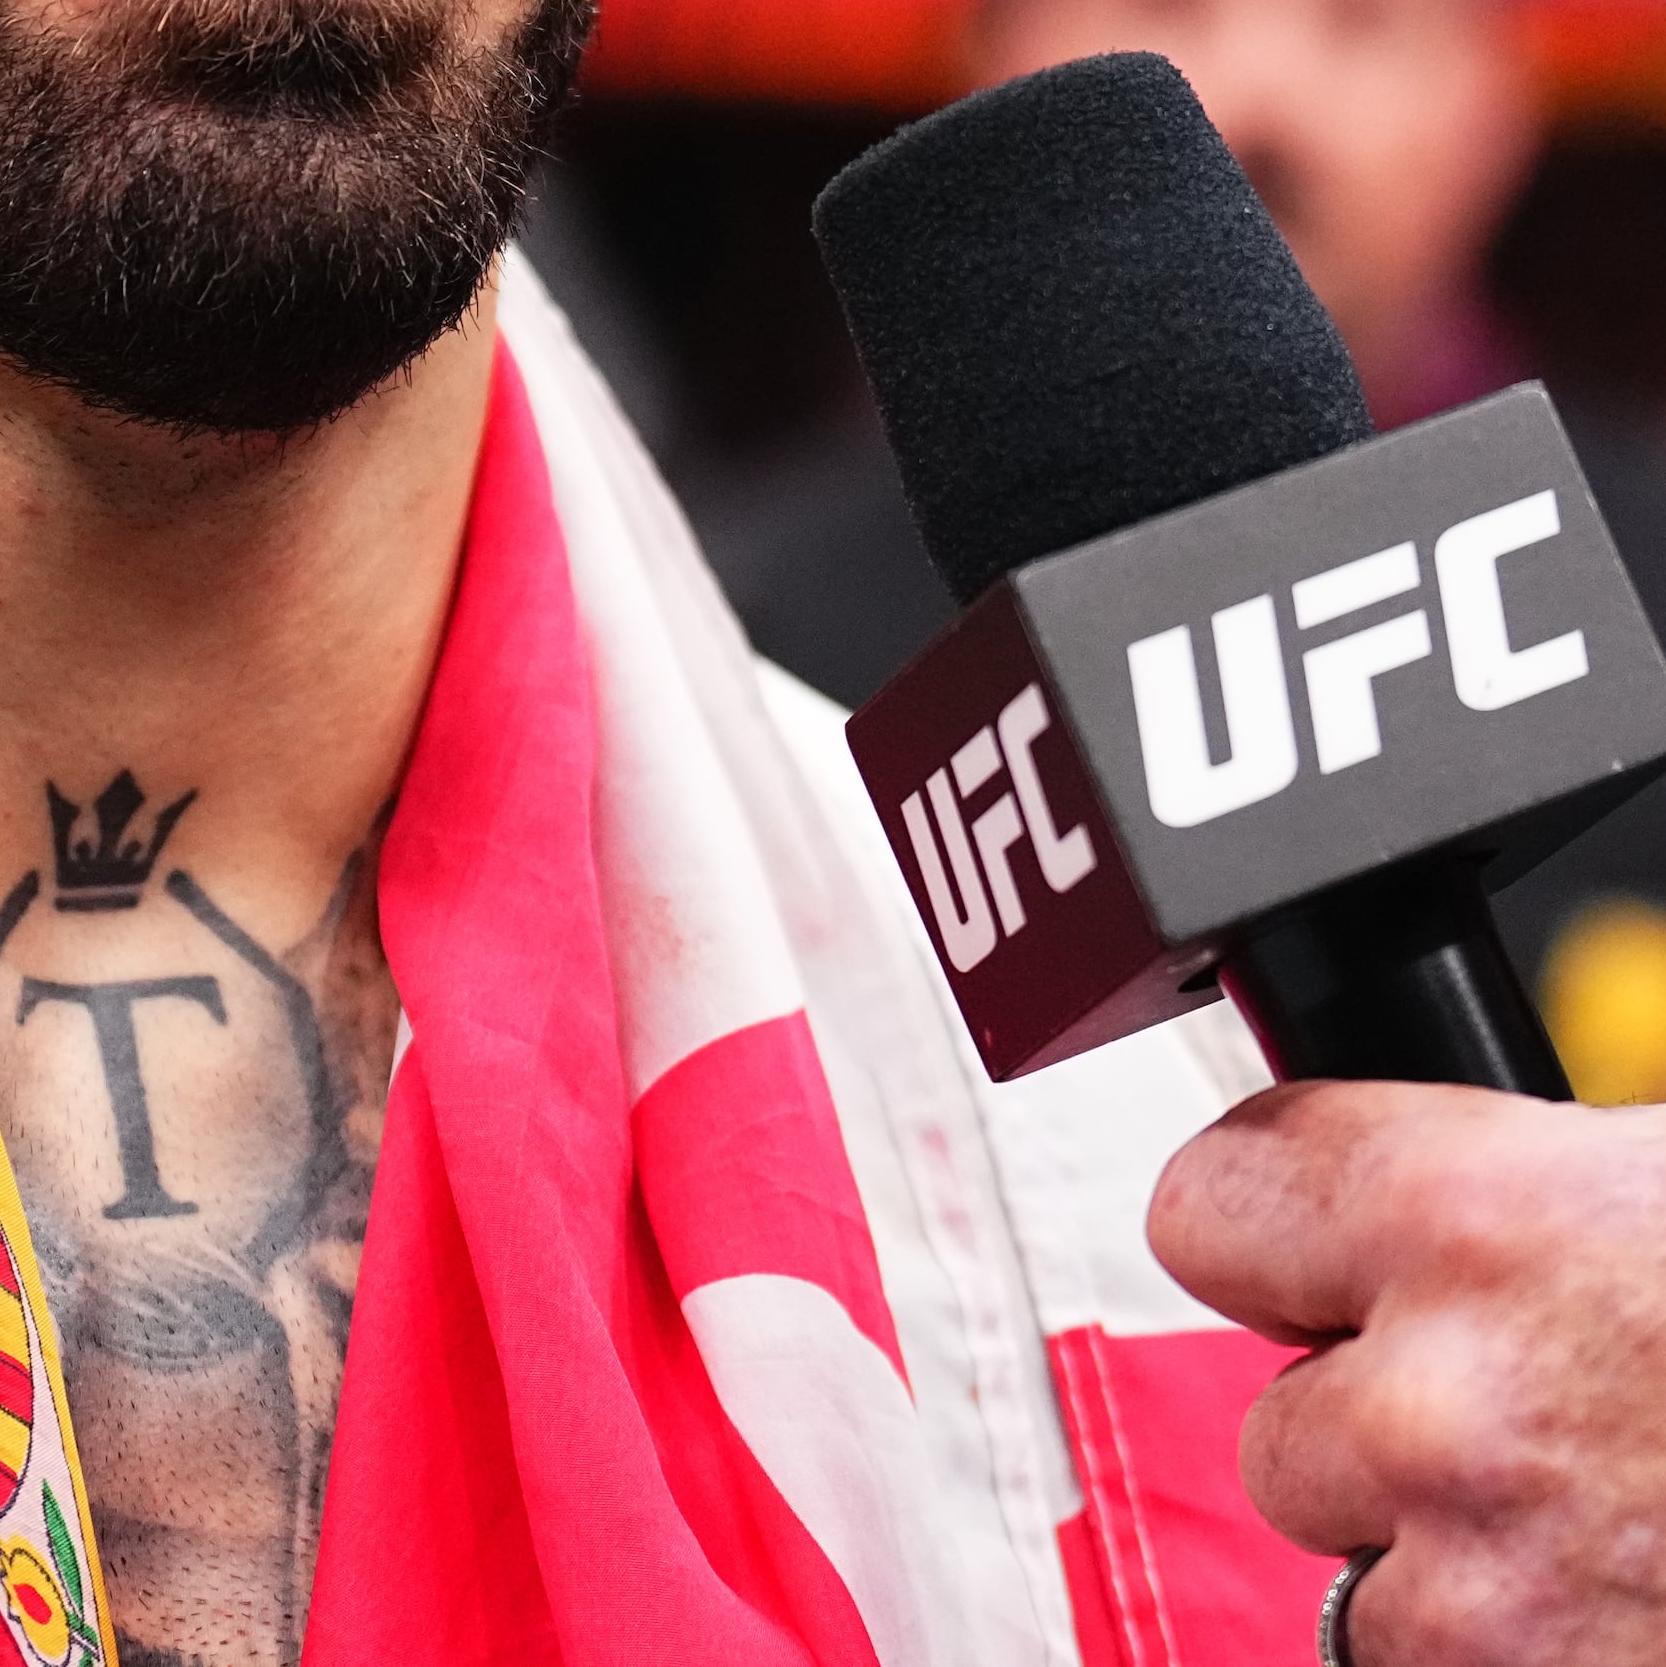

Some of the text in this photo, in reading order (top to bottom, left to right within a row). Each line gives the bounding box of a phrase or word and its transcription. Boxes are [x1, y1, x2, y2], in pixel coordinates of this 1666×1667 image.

[1126, 488, 1590, 828] UFC
[900, 681, 1098, 974] UFC
[16, 973, 228, 1222] T
